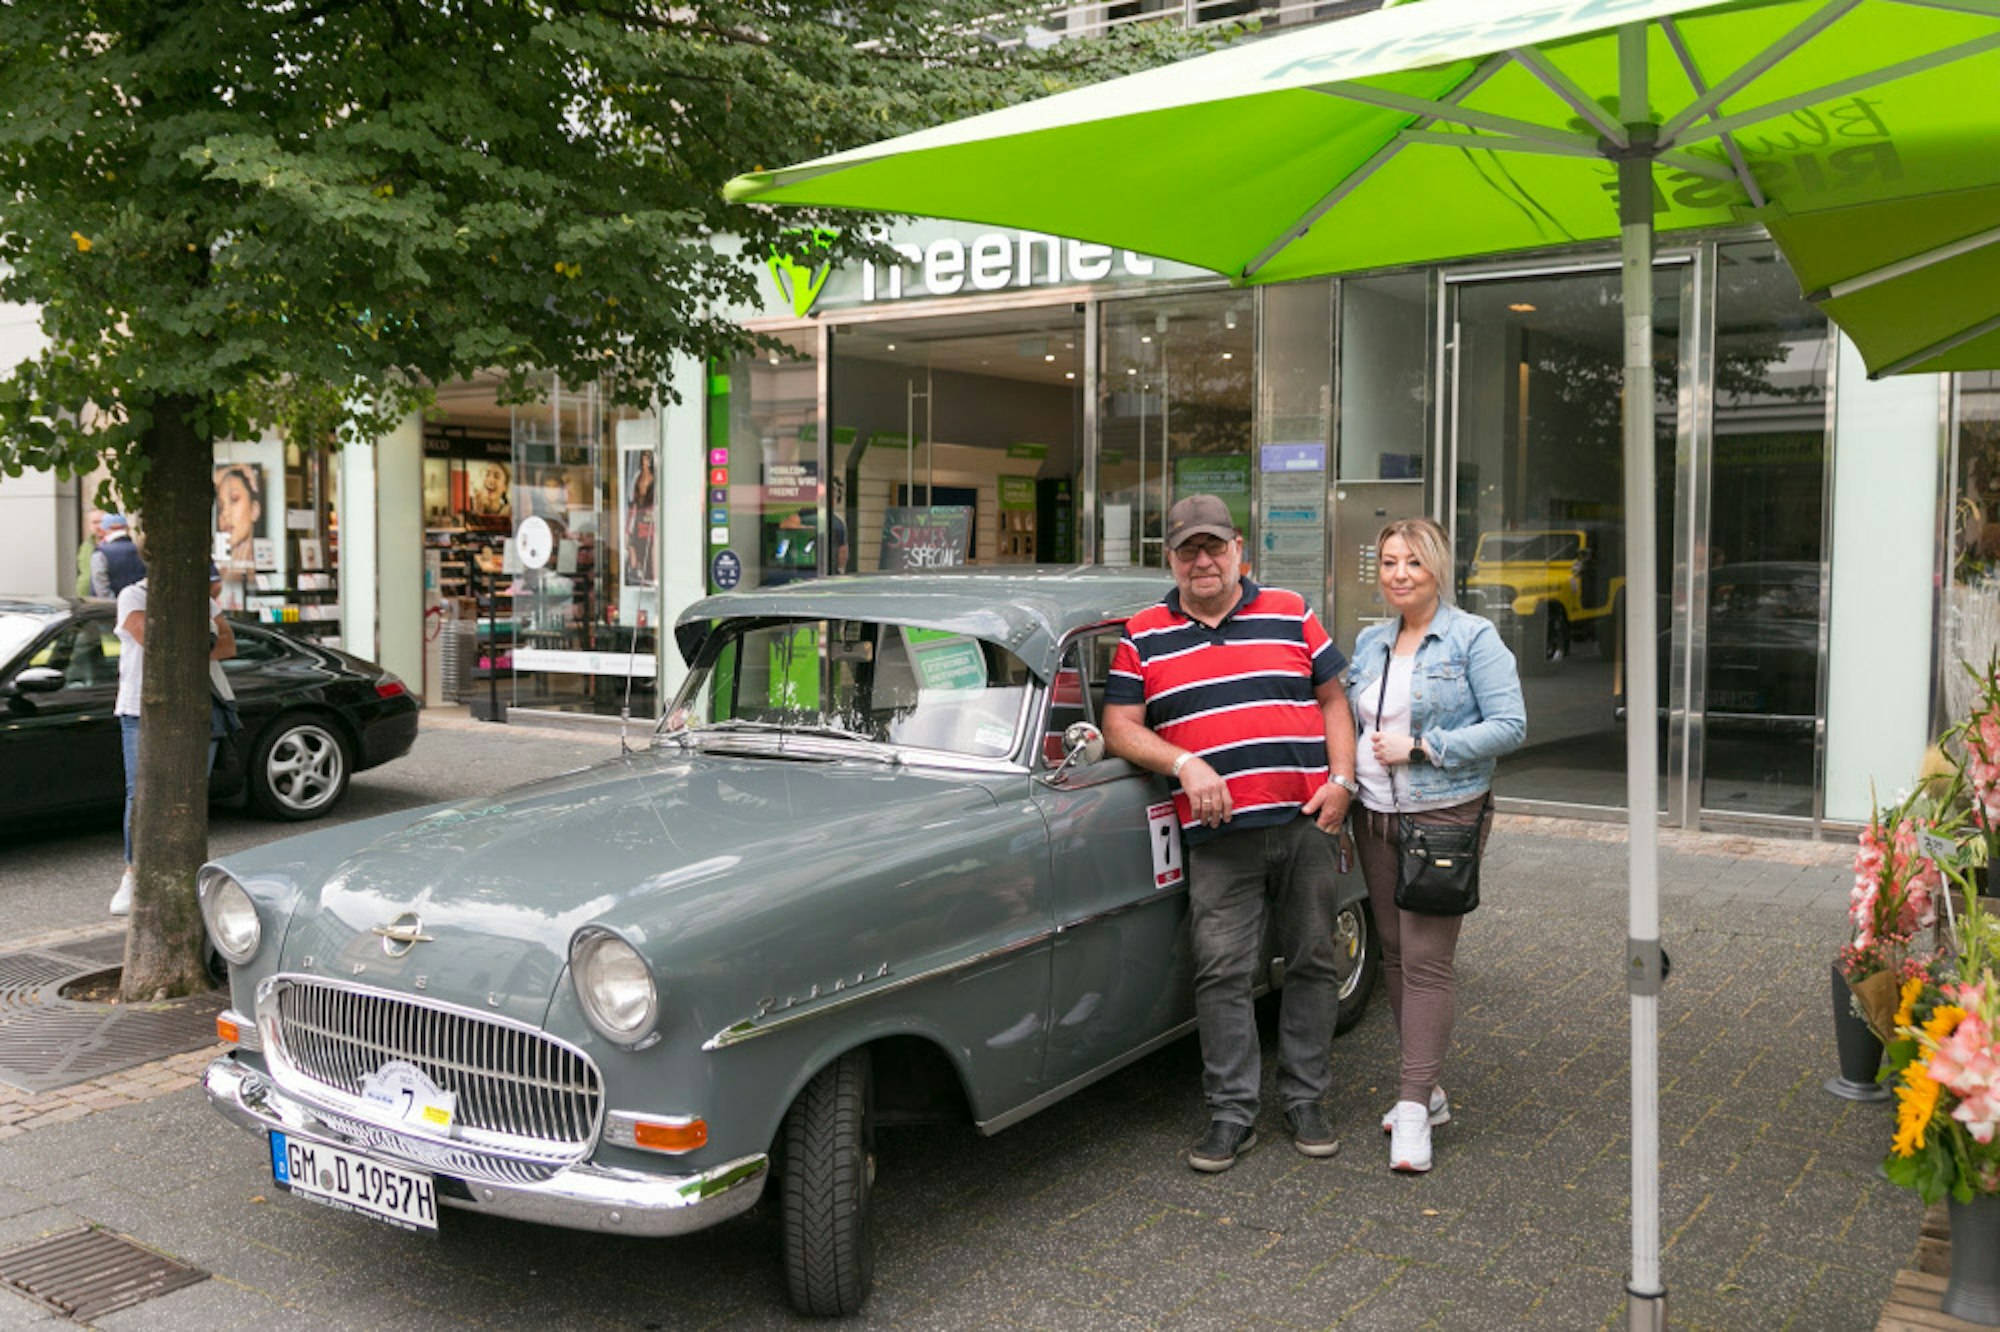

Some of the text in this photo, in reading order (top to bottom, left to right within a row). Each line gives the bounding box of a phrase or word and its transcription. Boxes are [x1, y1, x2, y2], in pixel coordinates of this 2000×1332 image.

[768, 487, 800, 497] FREENET
[303, 955, 500, 1008] OPEL
[402, 1087, 414, 1120] 7
[288, 1143, 318, 1187] GM
[334, 1155, 351, 1195] D
[356, 1161, 435, 1221] 1957H
